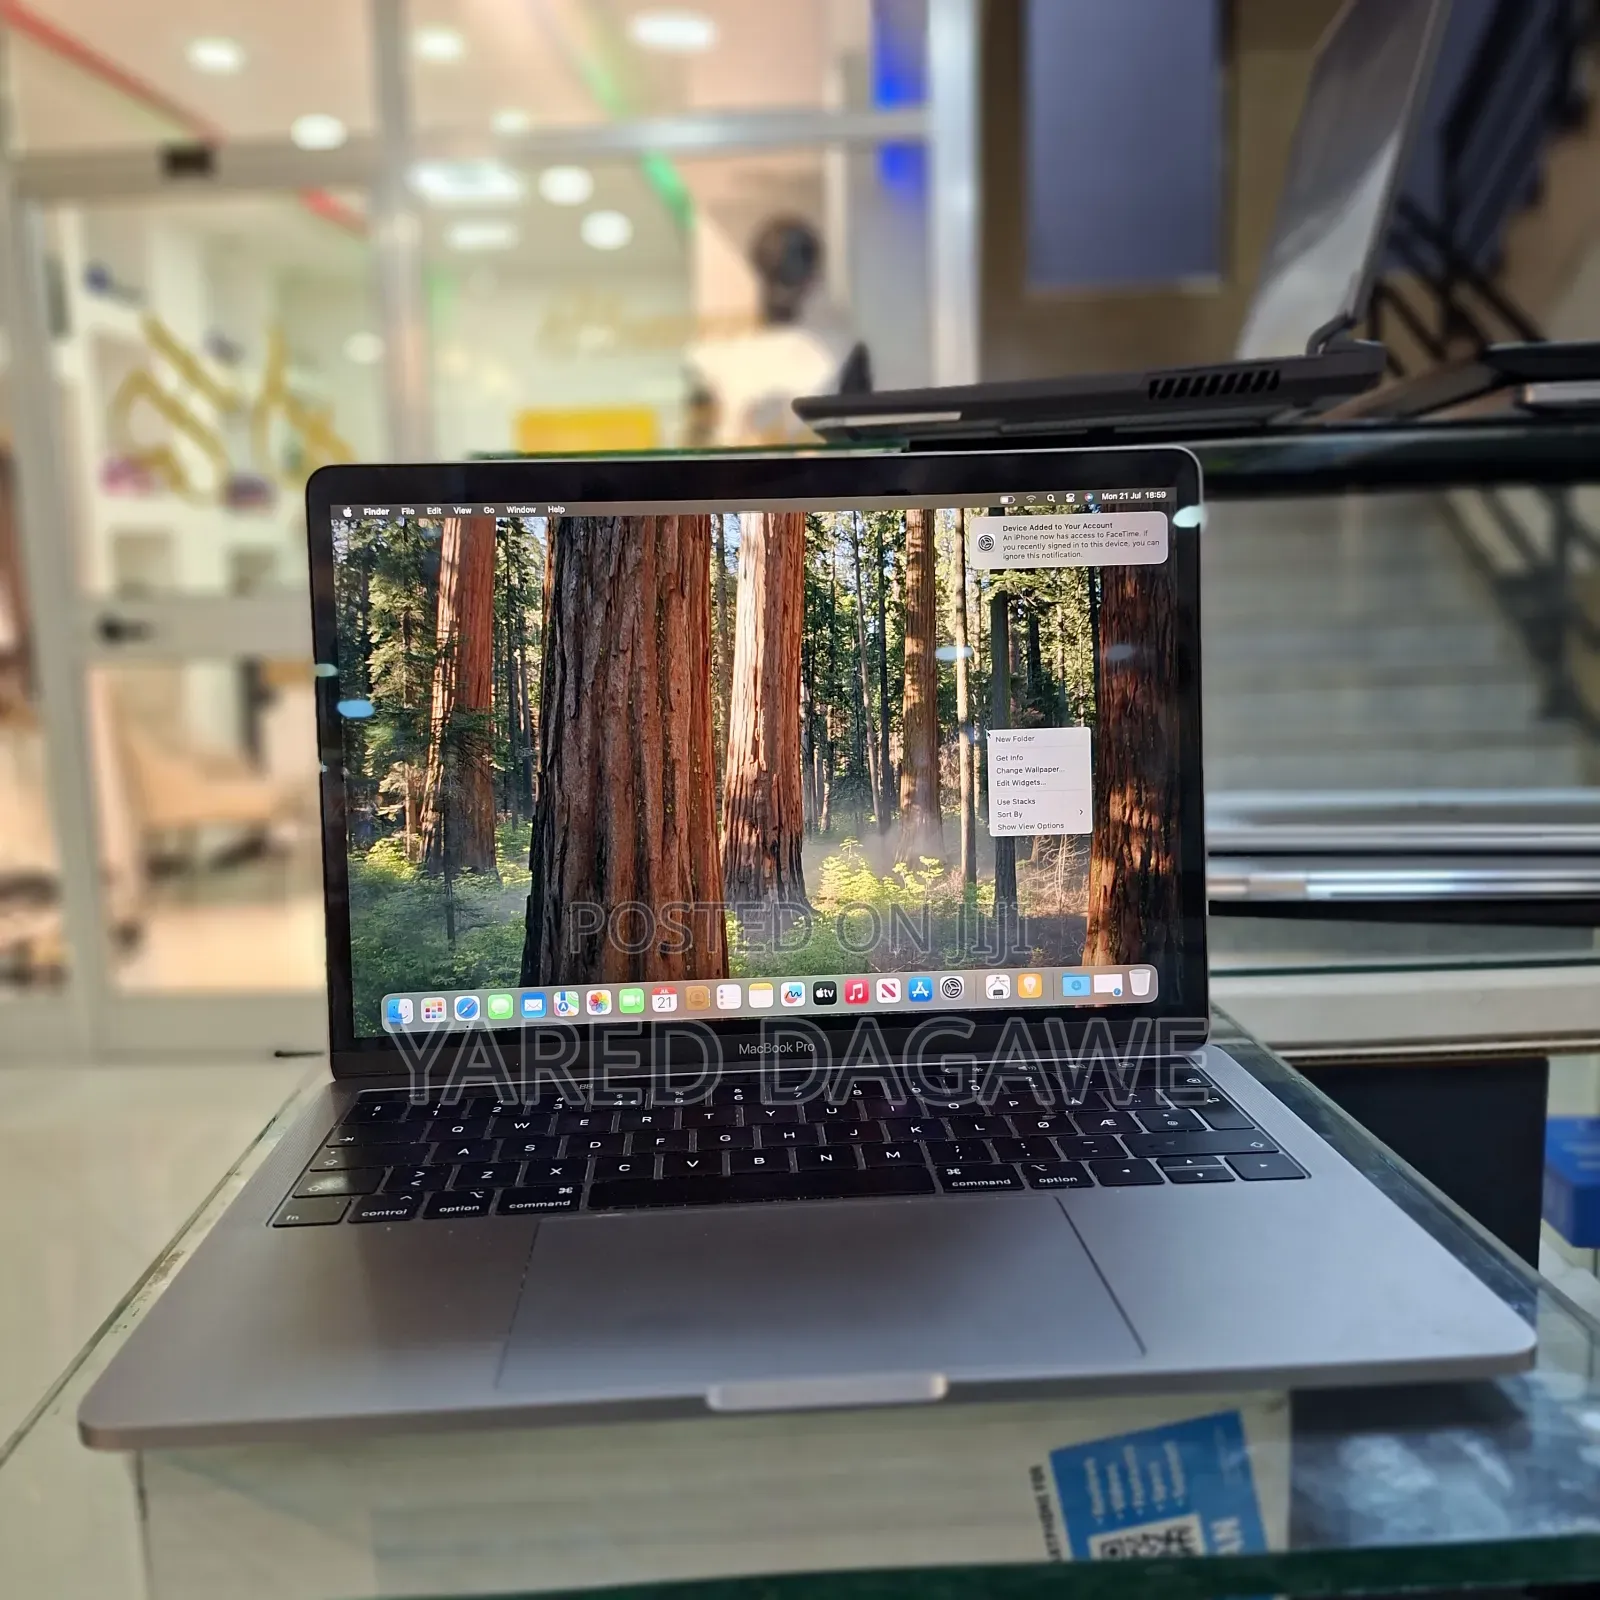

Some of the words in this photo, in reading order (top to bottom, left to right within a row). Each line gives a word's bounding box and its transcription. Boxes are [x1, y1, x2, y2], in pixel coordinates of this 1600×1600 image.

[1119, 492, 1128, 500] 21
[1130, 492, 1141, 500] Jul
[1145, 491, 1166, 499] 18:59
[363, 507, 390, 516] Finder
[401, 507, 415, 515] File
[427, 507, 442, 515] Edit
[453, 506, 472, 515] View
[483, 506, 495, 515] Go
[506, 505, 536, 514] Window
[548, 505, 565, 514] Help
[1002, 544, 1016, 552] you
[1017, 543, 1046, 551] recently
[1047, 542, 1072, 550] signed
[1105, 540, 1130, 548] device,
[1041, 551, 1083, 559] notification.
[1036, 822, 1065, 830] Options
[657, 996, 672, 1009] 21
[739, 1042, 793, 1055] MacBook
[796, 1041, 815, 1052] Pro
[451, 1125, 464, 1133] Q
[457, 1147, 470, 1155] A
[590, 1141, 601, 1149] D
[783, 1131, 796, 1139] H
[481, 1171, 494, 1179] Z
[550, 1167, 563, 1175] X
[686, 1160, 699, 1168] V
[754, 1157, 765, 1165] B
[820, 1154, 833, 1162] N
[286, 1213, 300, 1221] fn
[361, 1208, 408, 1217] control
[439, 1204, 480, 1213] option
[508, 1199, 571, 1209] command
[952, 1178, 1012, 1187] command
[1039, 1176, 1079, 1185] option
